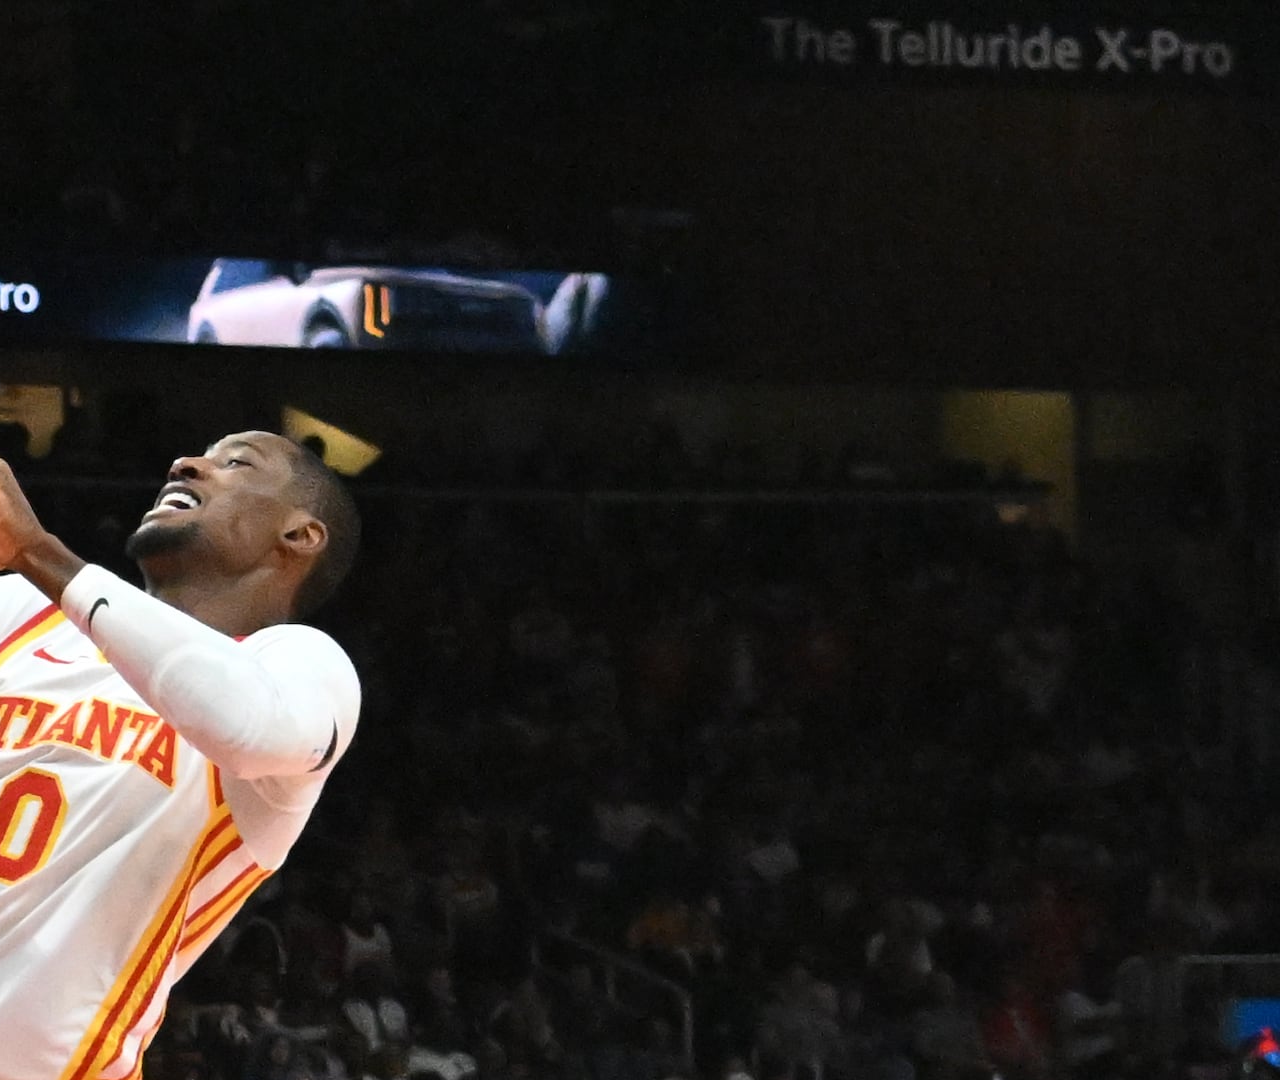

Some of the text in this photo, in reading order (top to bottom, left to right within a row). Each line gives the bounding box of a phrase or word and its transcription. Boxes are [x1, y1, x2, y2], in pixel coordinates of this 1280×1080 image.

[759, 16, 1233, 78] The Telluride X-Pro
